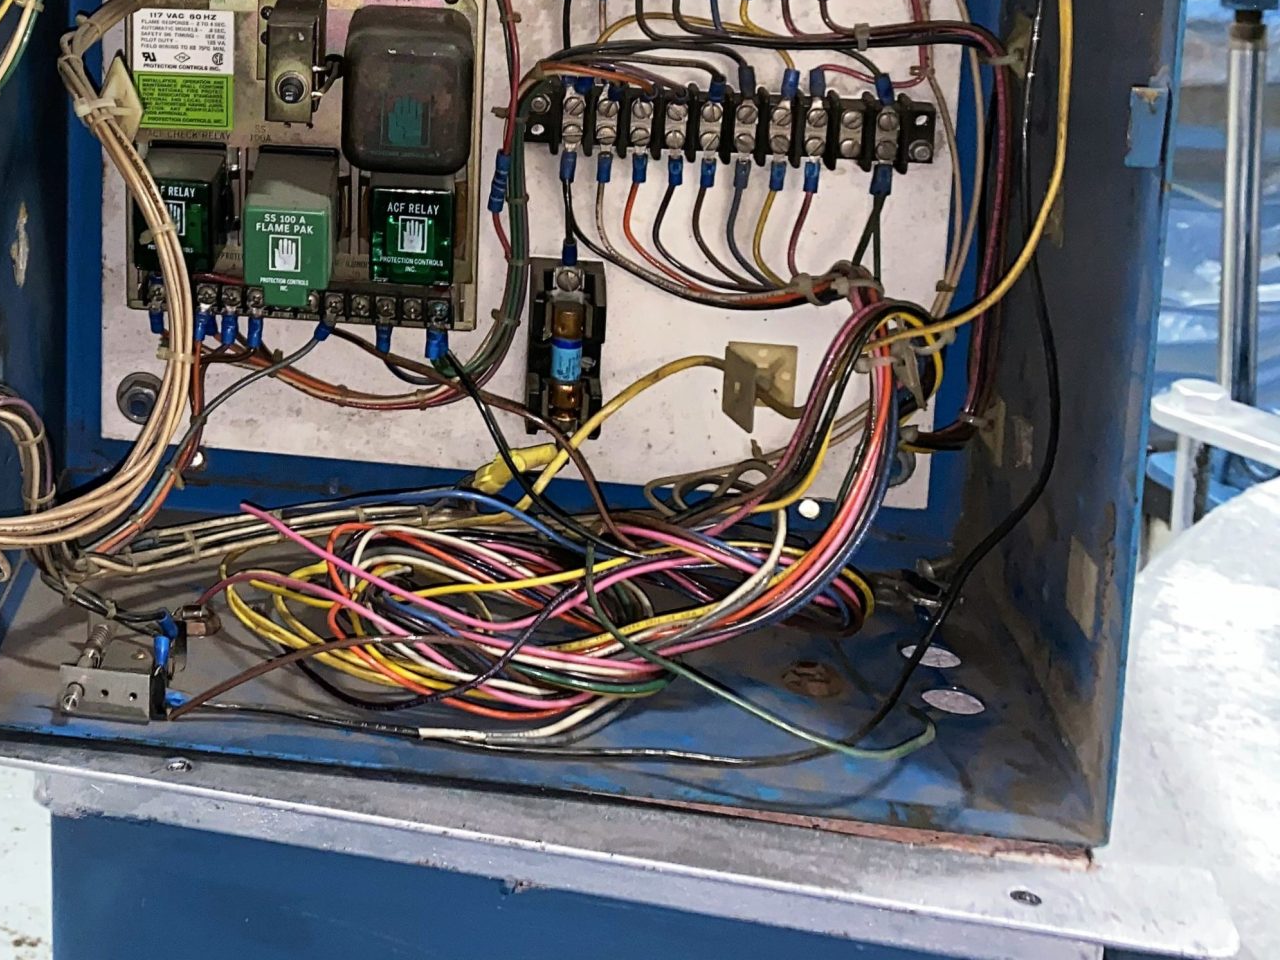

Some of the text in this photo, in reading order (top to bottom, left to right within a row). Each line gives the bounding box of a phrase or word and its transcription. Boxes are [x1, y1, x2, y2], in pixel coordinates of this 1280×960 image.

[202, 131, 230, 140] RELAY
[168, 186, 196, 198] RELAY
[387, 202, 439, 215] ACF RELAY
[280, 215, 296, 224] 100
[256, 224, 314, 234] FLAME PAK
[380, 256, 444, 266] PROTECTION CONTROLS
[287, 278, 308, 286] CONTROLS
